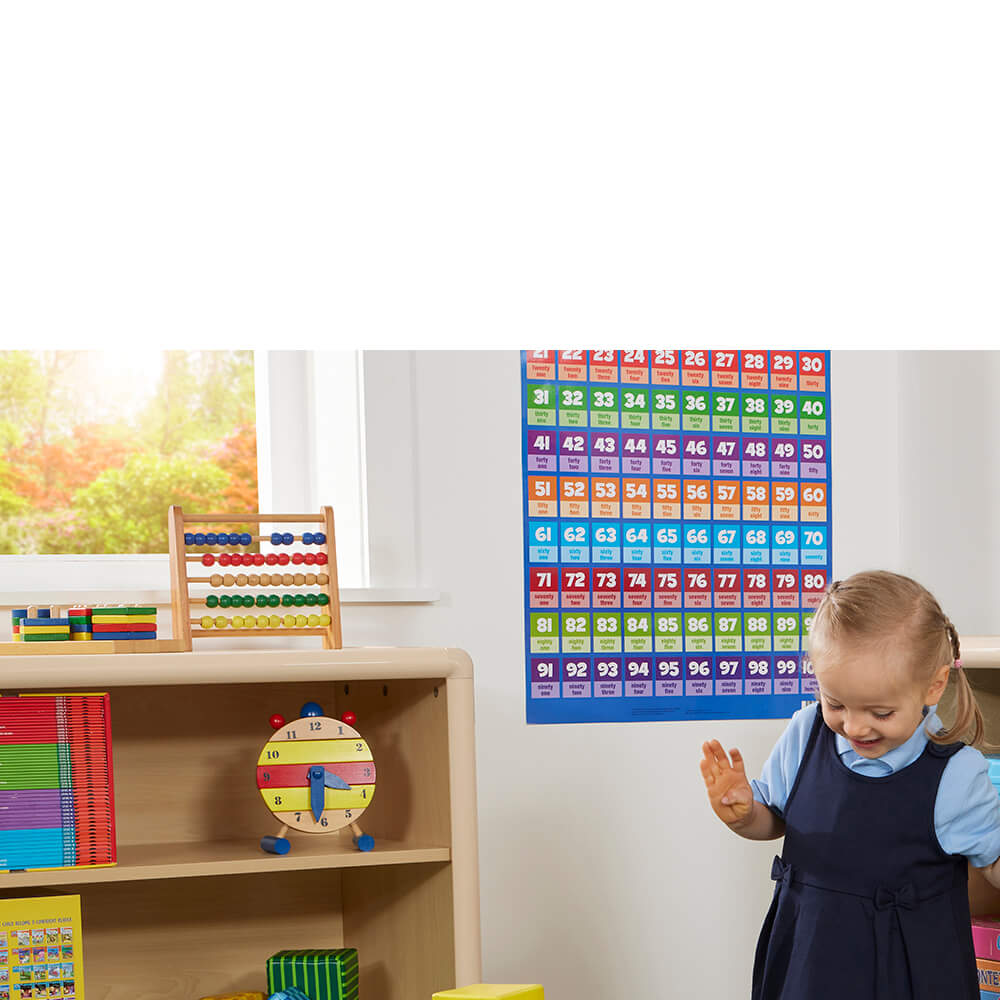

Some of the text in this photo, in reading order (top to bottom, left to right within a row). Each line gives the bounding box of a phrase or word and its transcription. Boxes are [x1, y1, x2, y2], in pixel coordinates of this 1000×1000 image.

[593, 350, 614, 362] 23
[624, 350, 646, 363] 24
[655, 350, 676, 365] 25
[685, 351, 705, 366] 26
[716, 353, 734, 367] 27
[745, 354, 764, 368] 28
[774, 356, 793, 369] 29
[802, 357, 822, 372] 30
[534, 390, 823, 415] 31 32 33 34 35 36 37 38 39 40
[534, 436, 823, 458] 41 42 43 44 45 46 47 48 49 50
[536, 482, 824, 502] 51 52 53 54 55 56 57 58 59 60
[536, 527, 823, 545] 61 62 63 64 65 66 67 68 69 70
[537, 573, 824, 588] 71 72 73 74 75 76 77 78 79 80
[537, 618, 552, 632] 81
[566, 618, 585, 632] 82
[598, 618, 617, 632] 83
[628, 618, 648, 632] 84
[658, 618, 678, 632] 85
[688, 618, 708, 632] 86
[719, 618, 737, 631] 87
[748, 618, 767, 632] 88
[777, 618, 796, 631] 89
[538, 661, 795, 677] 91 92 93 94 95 96 97 98 99
[310, 721, 322, 731] 12
[337, 726, 344, 735] 1
[287, 730, 297, 740] 11
[355, 743, 363, 752] 2
[267, 750, 280, 760] 10
[263, 772, 270, 782] 9
[363, 768, 371, 777] 3
[360, 789, 367, 799] 4
[274, 796, 282, 806] 8
[295, 812, 302, 822] 7
[345, 809, 352, 818] 5
[320, 817, 328, 827] 6
